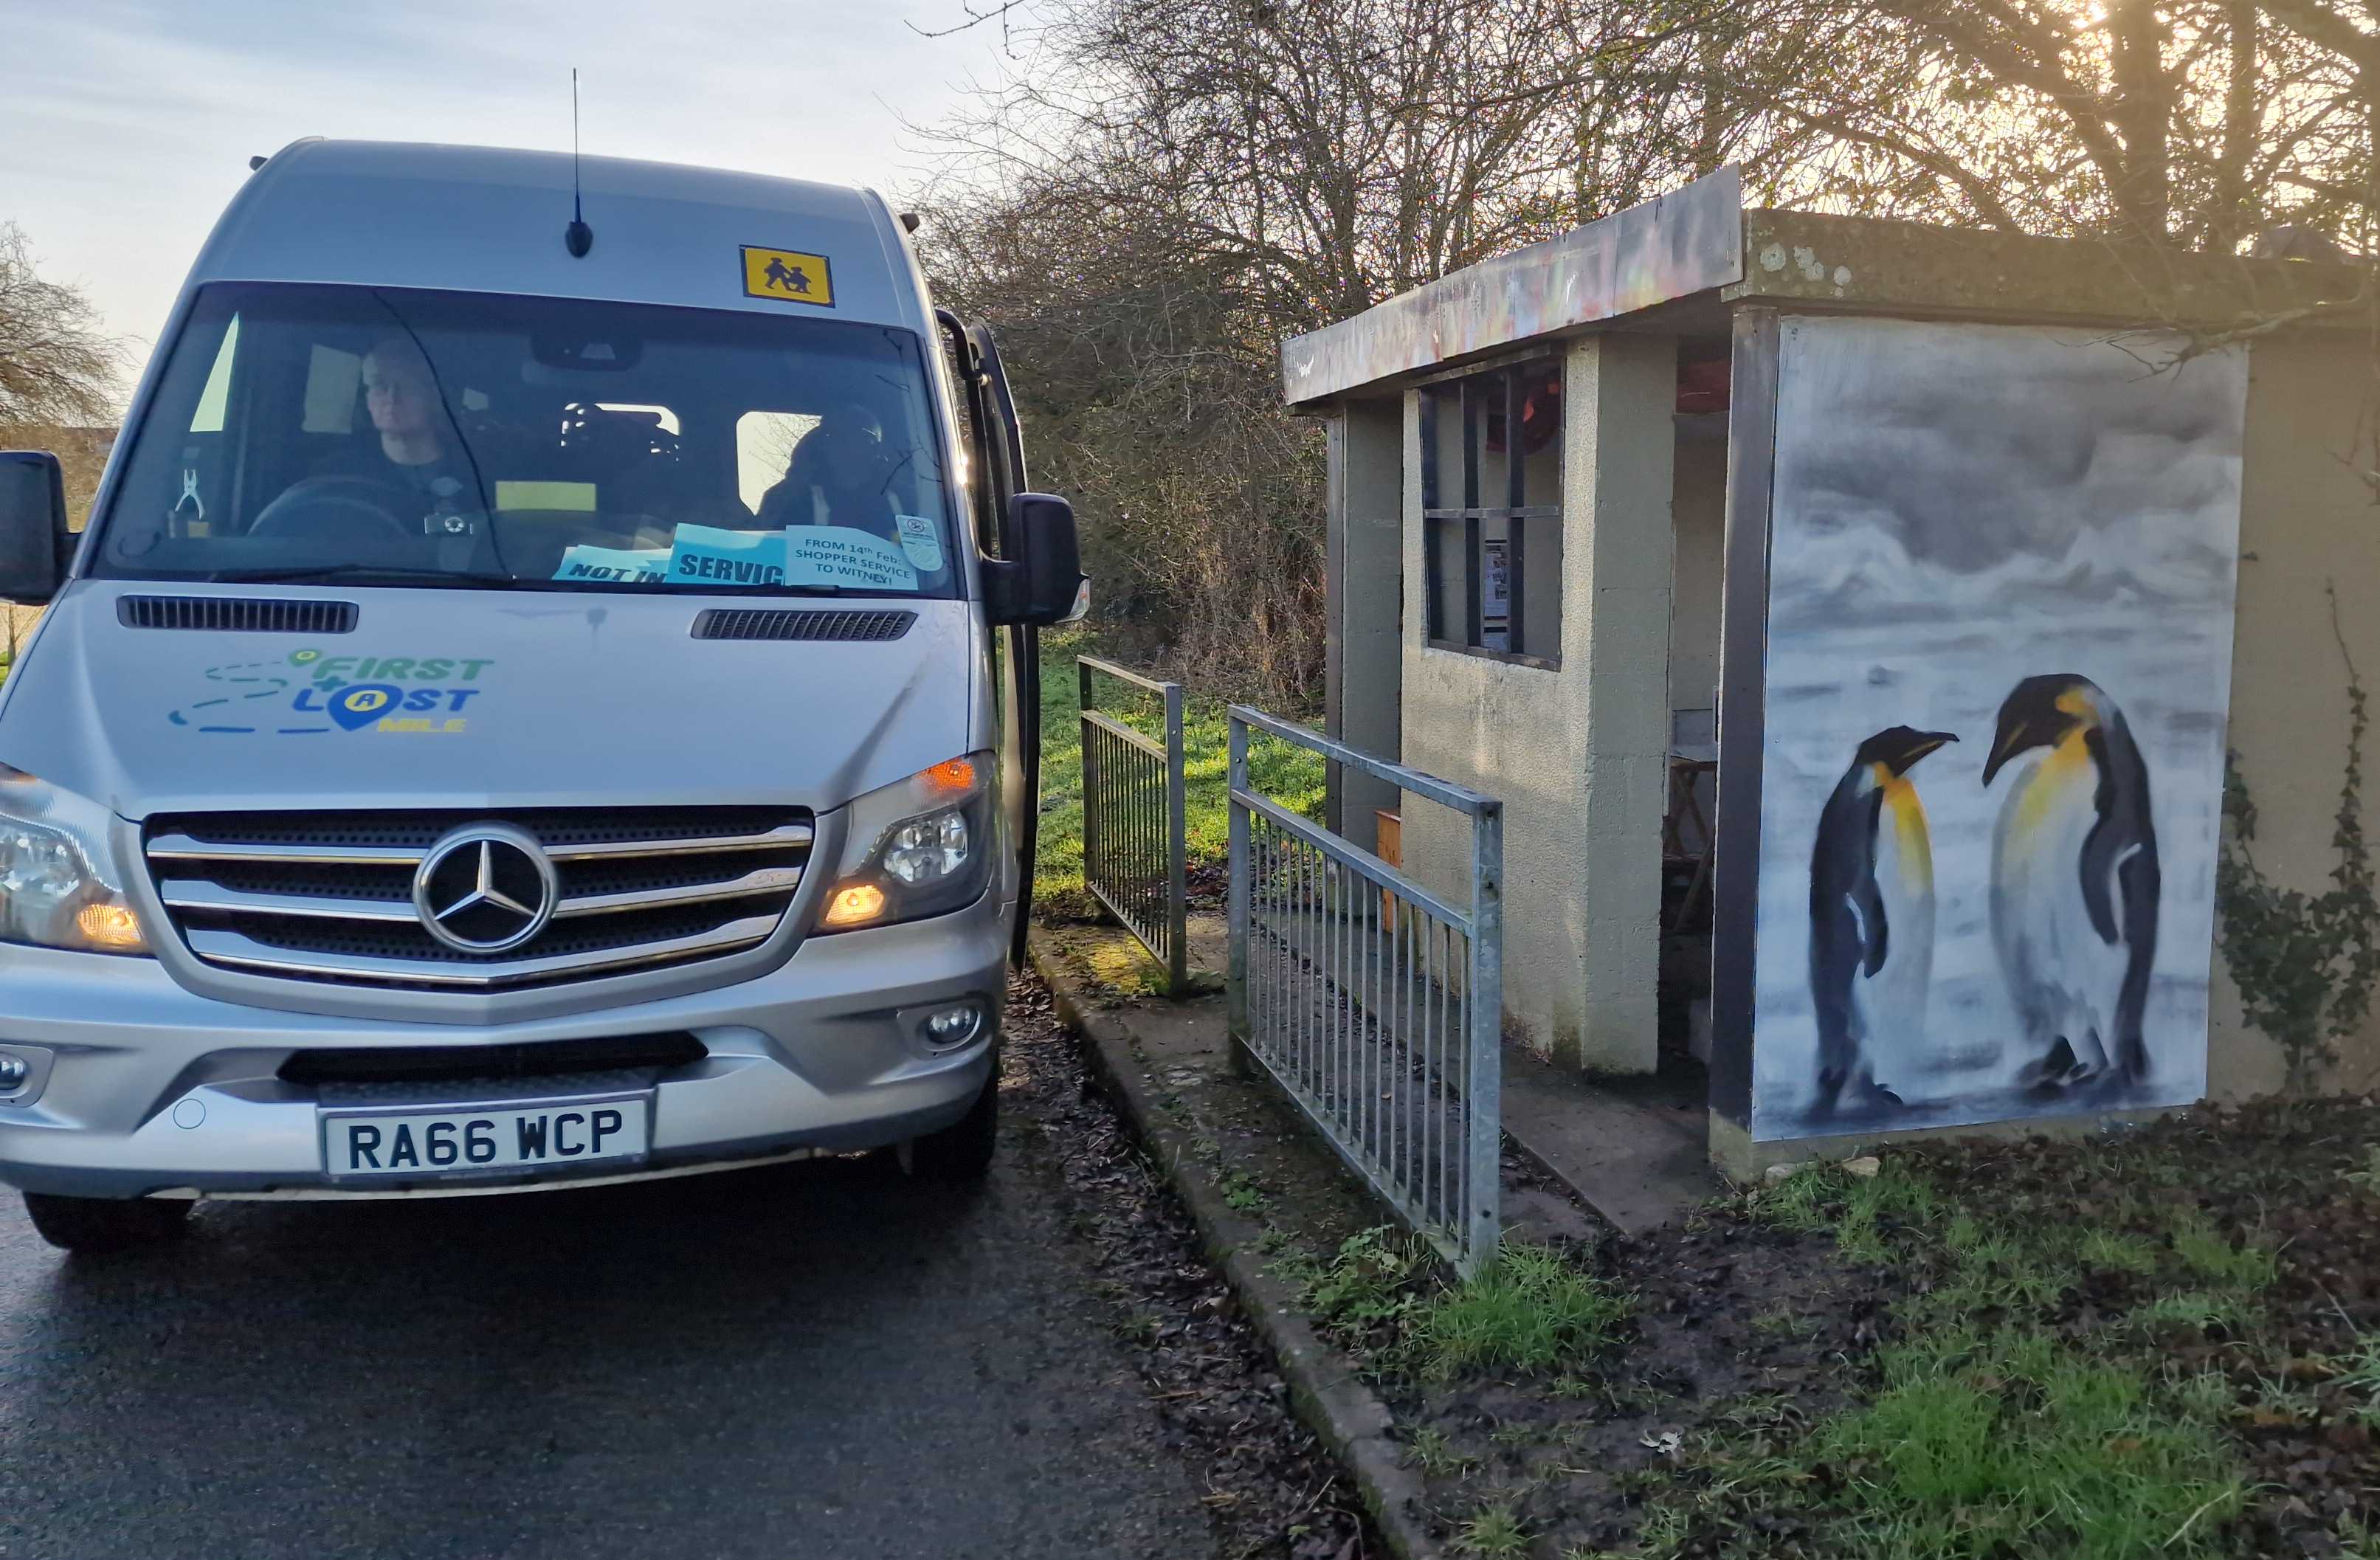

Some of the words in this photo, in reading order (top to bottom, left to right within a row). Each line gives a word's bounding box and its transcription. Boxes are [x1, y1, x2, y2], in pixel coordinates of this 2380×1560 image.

[805, 539, 845, 551] FROM
[850, 545, 873, 554] 14th
[569, 563, 632, 581] NOT
[632, 570, 668, 583] IN
[678, 554, 786, 585] SERVIC
[795, 549, 857, 565] SHOPPER
[860, 559, 910, 579] SERVICE
[815, 563, 833, 573] TO
[838, 566, 892, 585] WITNEY!
[311, 657, 495, 680] FIRST
[377, 718, 467, 732] MILE
[348, 1119, 496, 1169] RA66
[516, 1109, 622, 1161] WCP
